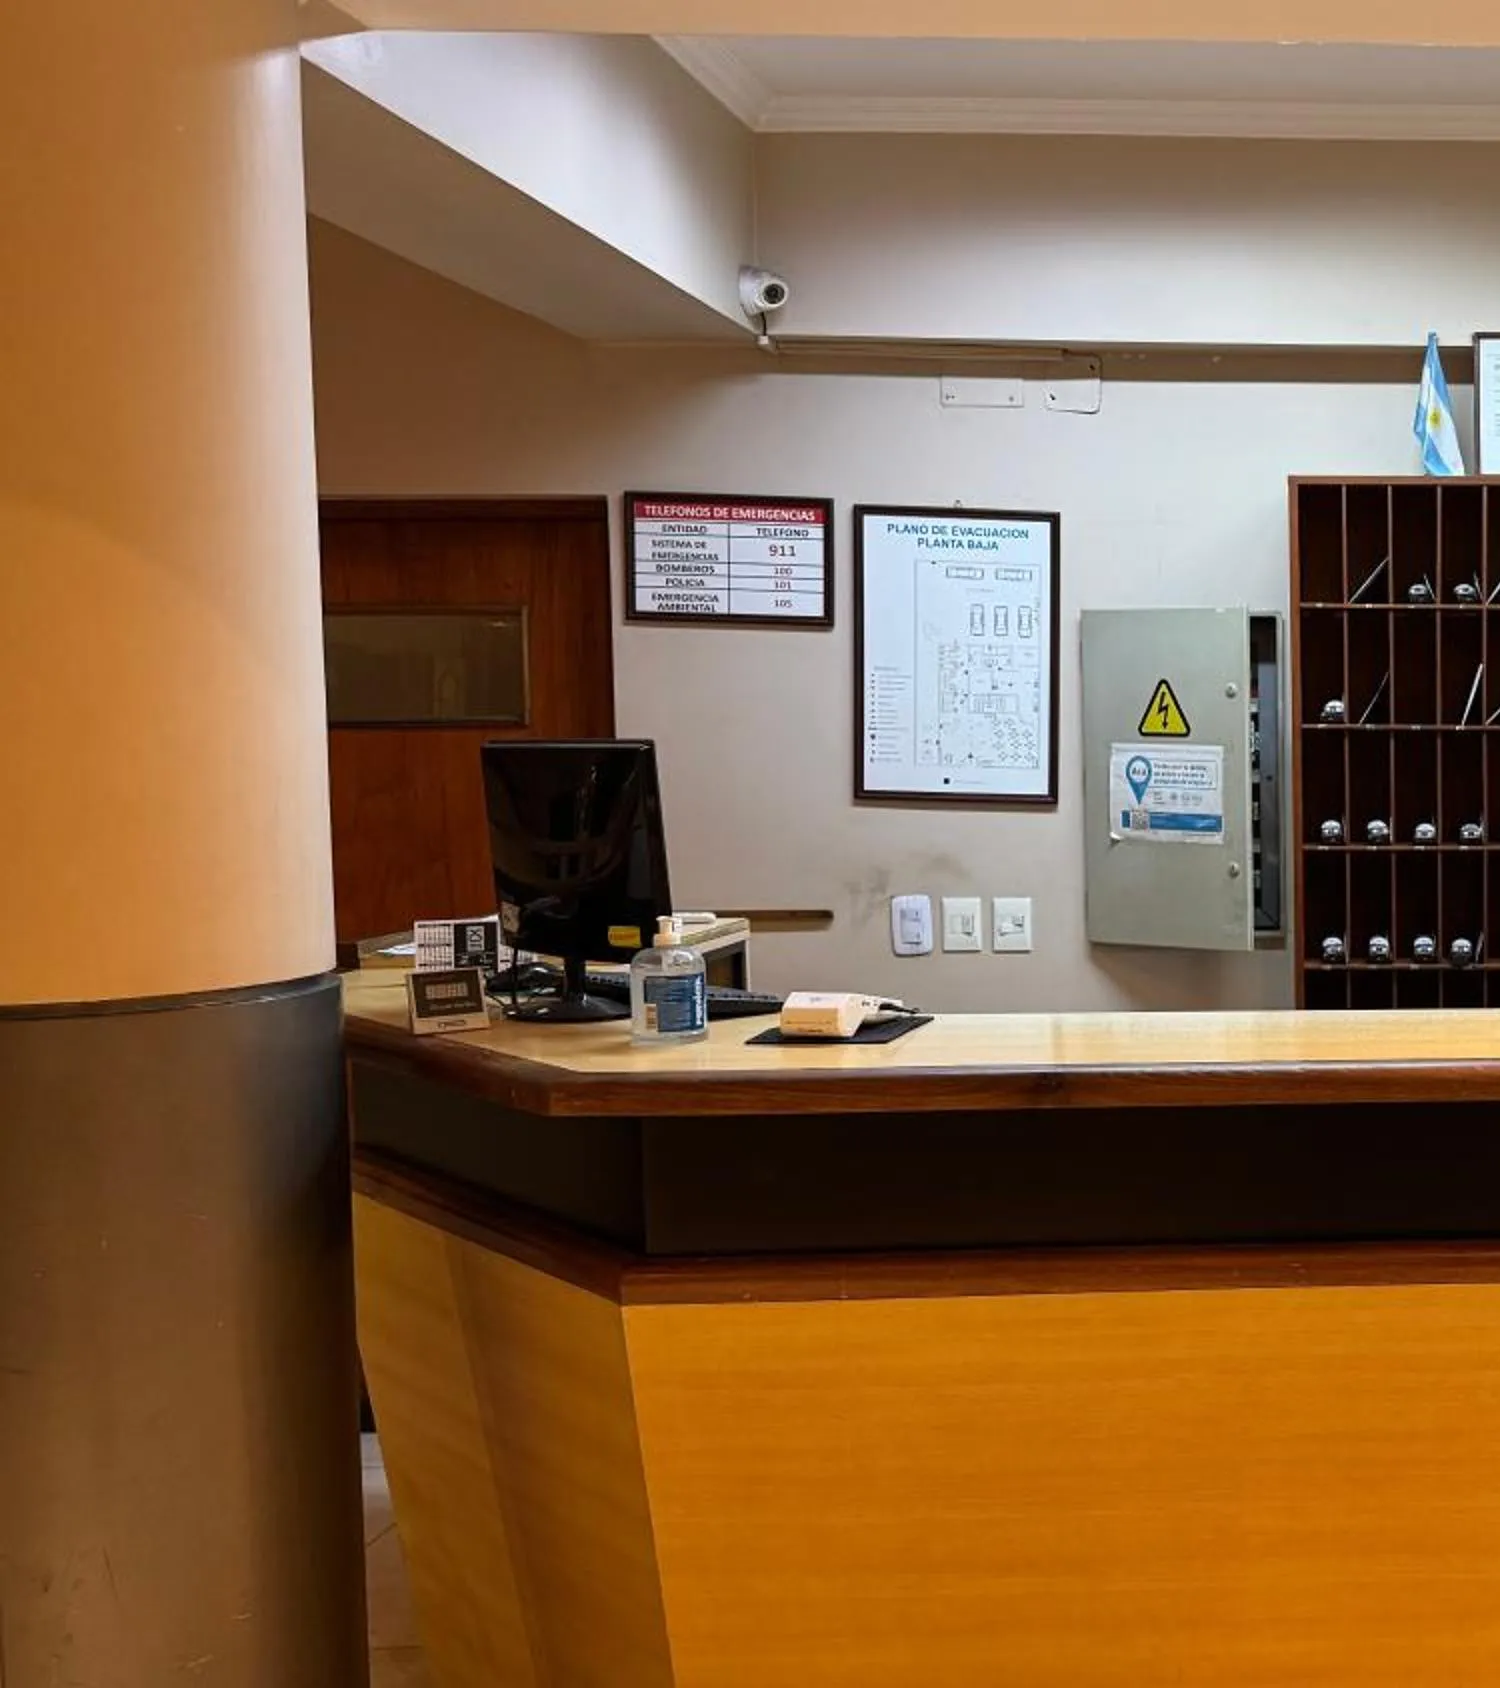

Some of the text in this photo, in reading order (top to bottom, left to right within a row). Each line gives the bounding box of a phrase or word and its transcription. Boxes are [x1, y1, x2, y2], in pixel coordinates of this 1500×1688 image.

[645, 504, 815, 520] TELEFONOS DE EMERGENCIAS
[662, 523, 707, 534] ENTIDAD
[756, 527, 809, 537] TELEFONO
[887, 523, 1029, 539] PLANO DE EVACUACION
[652, 540, 707, 549] SISTEMA DE
[917, 538, 999, 550] PLANTA BAJA
[768, 545, 796, 557] 911
[652, 552, 719, 562] EMERGENCIAS
[656, 564, 715, 575] BOMBEROS
[773, 567, 792, 576] 100
[665, 578, 705, 588] POLICIA
[773, 581, 792, 590] 101
[652, 593, 719, 603] EMERGENCIA
[657, 603, 716, 613] AMBIENTAL
[773, 599, 792, 608] 105
